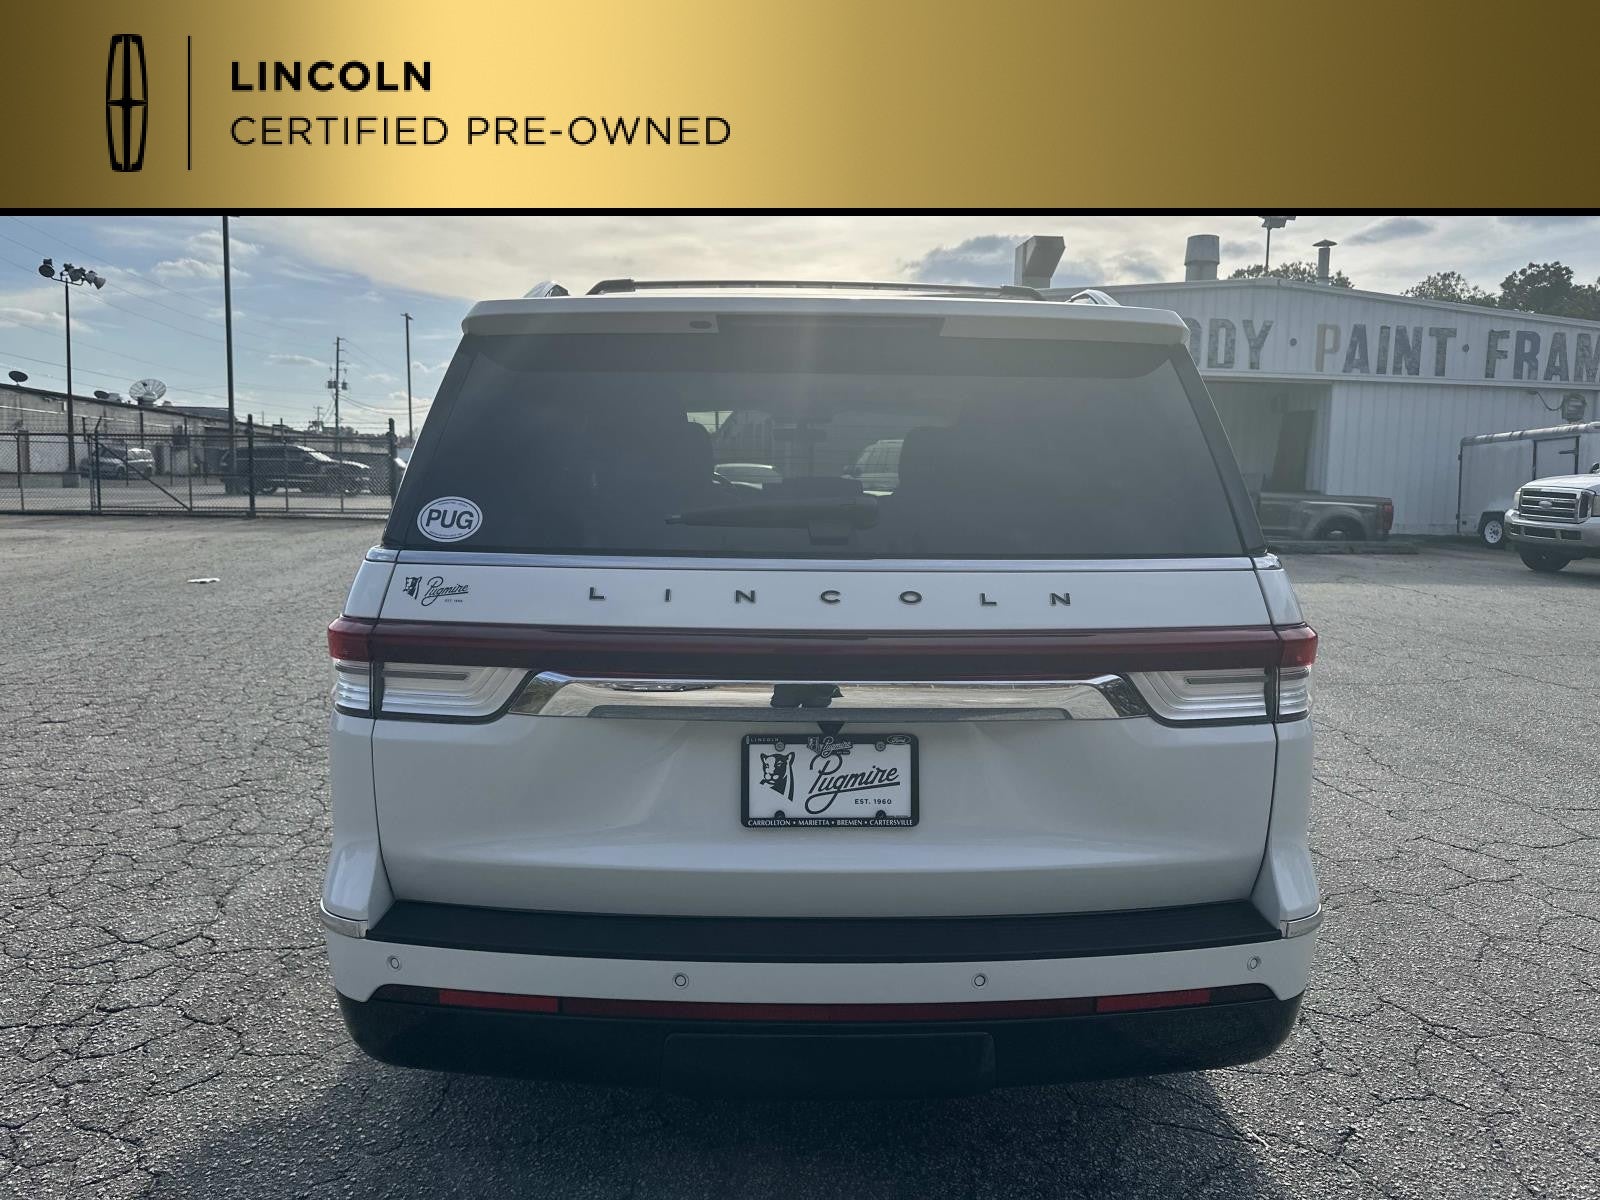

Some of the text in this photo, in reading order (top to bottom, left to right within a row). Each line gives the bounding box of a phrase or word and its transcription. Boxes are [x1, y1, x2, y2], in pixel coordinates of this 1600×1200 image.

[1315, 323, 1457, 377] PAINT
[425, 508, 474, 530] PUG
[421, 576, 469, 607] Pugmire
[588, 585, 1072, 607] LINCOLN
[804, 753, 900, 815] Pugmire
